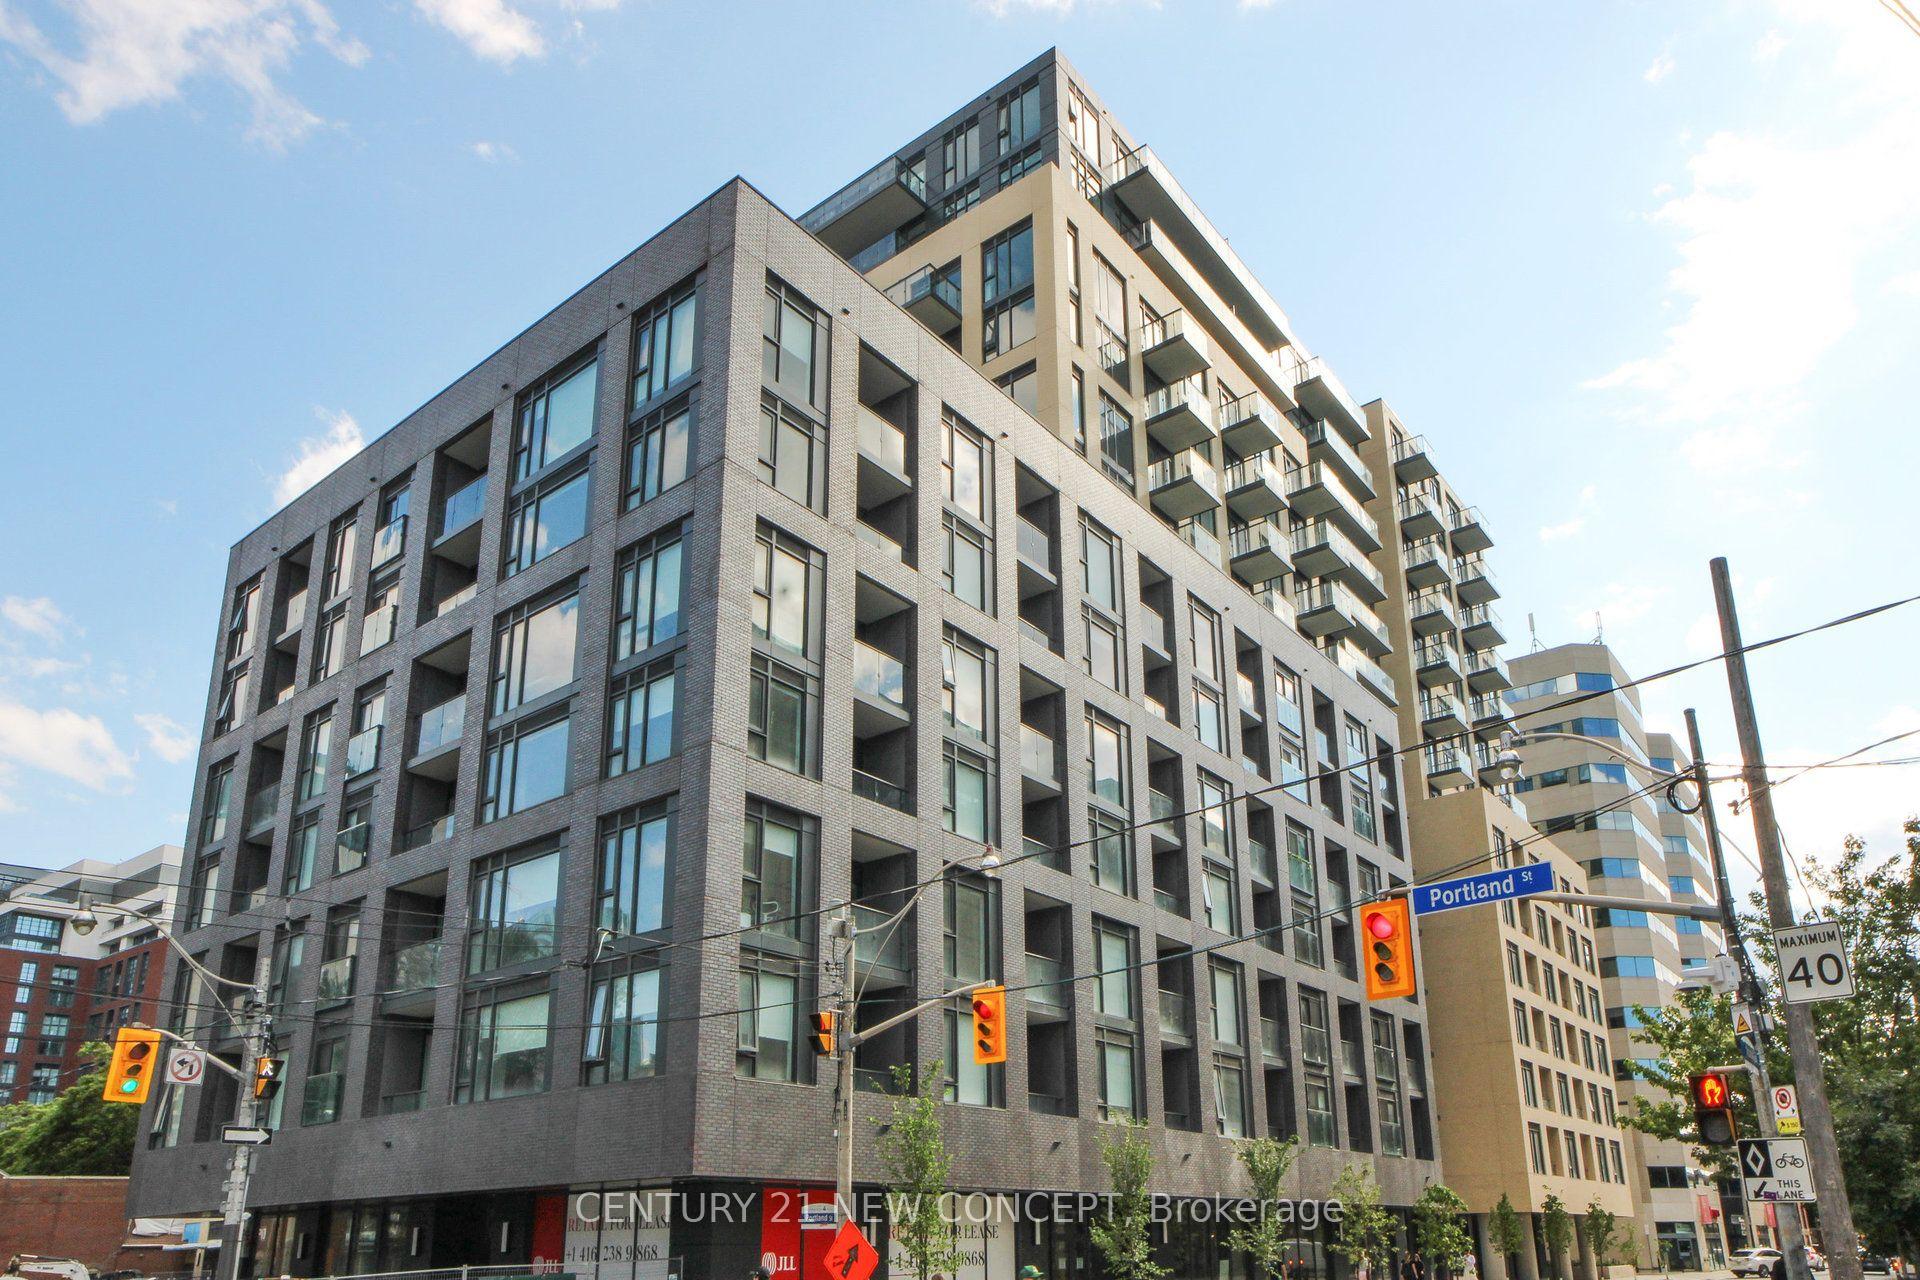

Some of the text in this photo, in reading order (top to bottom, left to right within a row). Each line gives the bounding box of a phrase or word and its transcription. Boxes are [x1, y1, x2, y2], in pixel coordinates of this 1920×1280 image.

[1430, 871, 1533, 907] Portland St
[1780, 931, 1836, 948] MAXIMUM
[1788, 953, 1843, 988] 40
[1777, 1180, 1801, 1188] THIS
[965, 1224, 998, 1239] LEASE
[566, 1244, 658, 1262] +1 416 238 9868
[777, 1256, 796, 1271] JLL
